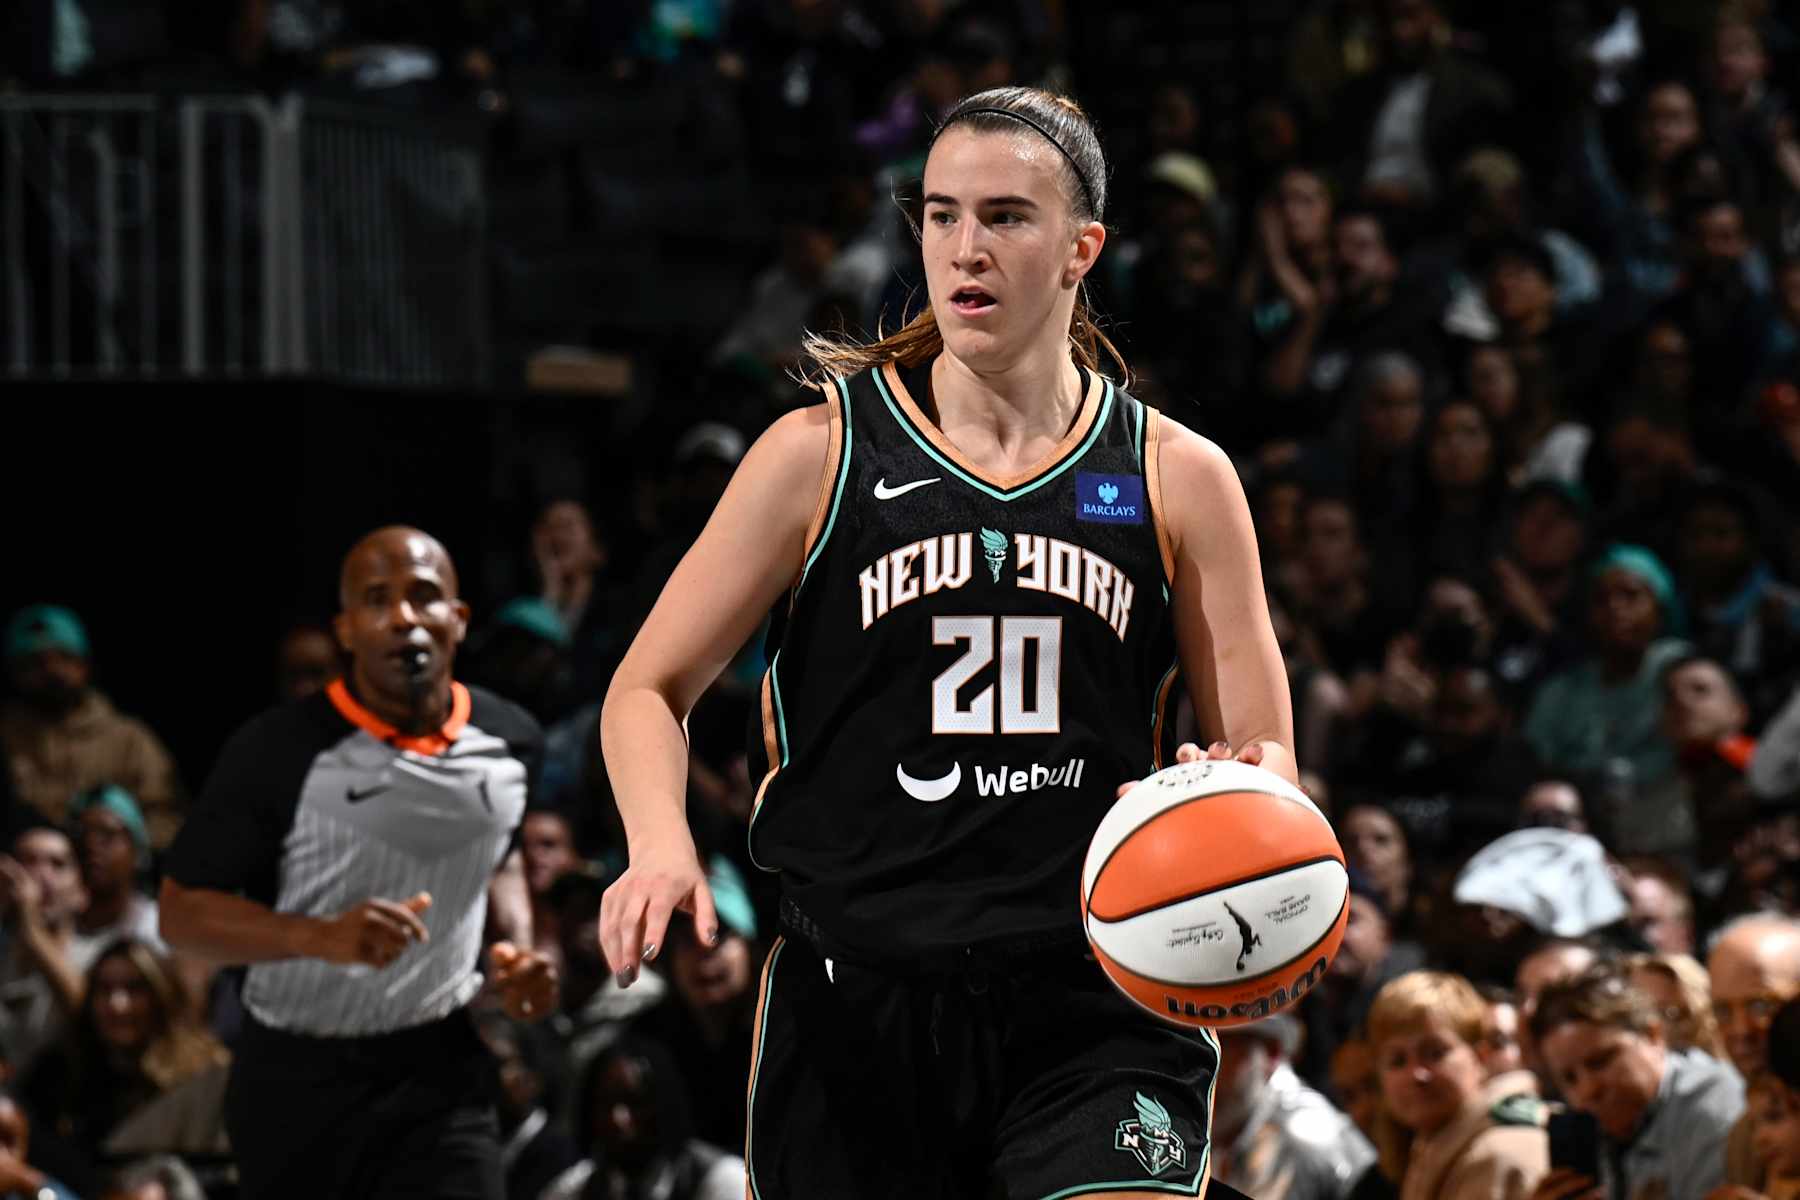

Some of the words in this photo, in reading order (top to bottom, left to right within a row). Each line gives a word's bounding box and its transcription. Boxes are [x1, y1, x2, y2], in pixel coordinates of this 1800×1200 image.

[1083, 503, 1137, 517] BARCLAYS
[858, 531, 974, 631] NEW
[1013, 532, 1136, 643] YORK
[931, 614, 1064, 736] 20
[974, 758, 1086, 797] Webull
